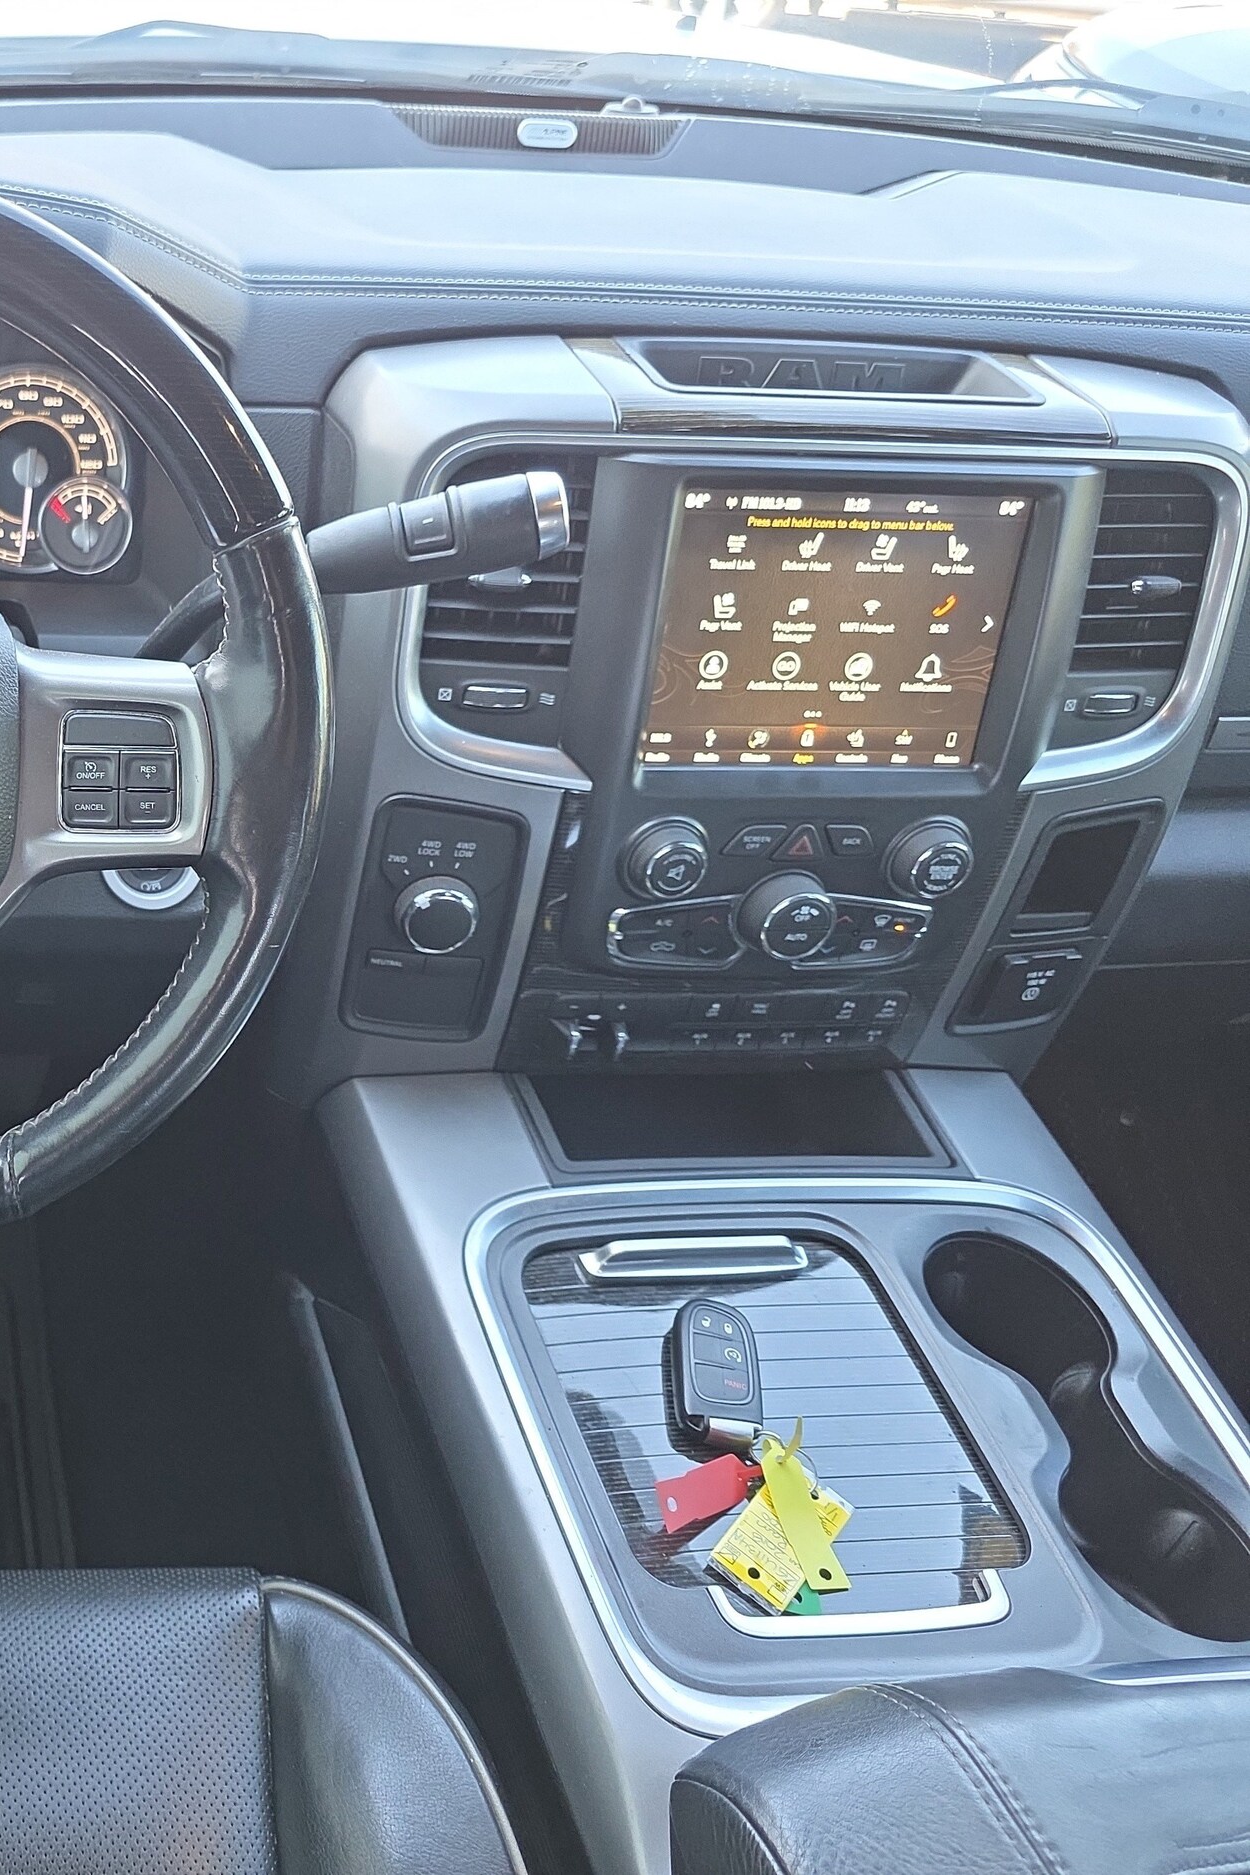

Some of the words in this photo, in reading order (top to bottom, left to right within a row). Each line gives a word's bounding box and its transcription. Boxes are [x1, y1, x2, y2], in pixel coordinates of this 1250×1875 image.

[697, 356, 906, 392] RAM
[747, 516, 771, 528] Press
[771, 517, 791, 528] and
[791, 517, 813, 529] hold
[813, 518, 837, 529] icons
[837, 519, 849, 529] to
[848, 518, 870, 532] drag
[870, 519, 881, 530] to
[881, 520, 909, 530] menu
[909, 520, 926, 531] bar
[926, 520, 954, 532] below.
[709, 558, 737, 571] Travel
[737, 558, 756, 571] Link
[781, 560, 809, 572] Driver
[809, 561, 832, 572] Heat
[855, 561, 883, 573] Driver
[883, 562, 905, 574] Vent
[952, 563, 975, 575] Heat
[720, 620, 743, 631] Vent
[772, 621, 817, 633] Projection
[860, 622, 896, 634] Hotspot
[929, 623, 950, 634] SOS
[772, 631, 813, 644] Manager
[696, 680, 723, 690] Assist
[746, 680, 782, 691] Activate
[782, 680, 819, 691] Services
[829, 681, 860, 692] Vehicle
[860, 681, 882, 692] User
[899, 681, 953, 693] Notifications
[839, 691, 866, 702] Guide
[792, 753, 815, 764] Apps
[74, 803, 106, 811] CANCEL
[421, 840, 442, 849] 4WD
[743, 835, 771, 843] SCREEN
[842, 838, 862, 846] BACK
[455, 842, 477, 850] 4WD
[418, 848, 441, 857] LOCK
[454, 850, 475, 858] LOW
[388, 854, 408, 863] 2WD
[655, 919, 674, 927] A/C
[794, 914, 811, 922] OFF
[784, 933, 808, 941] AUTO
[370, 958, 403, 967] NEUTRAL
[724, 1378, 747, 1391] PANIC
